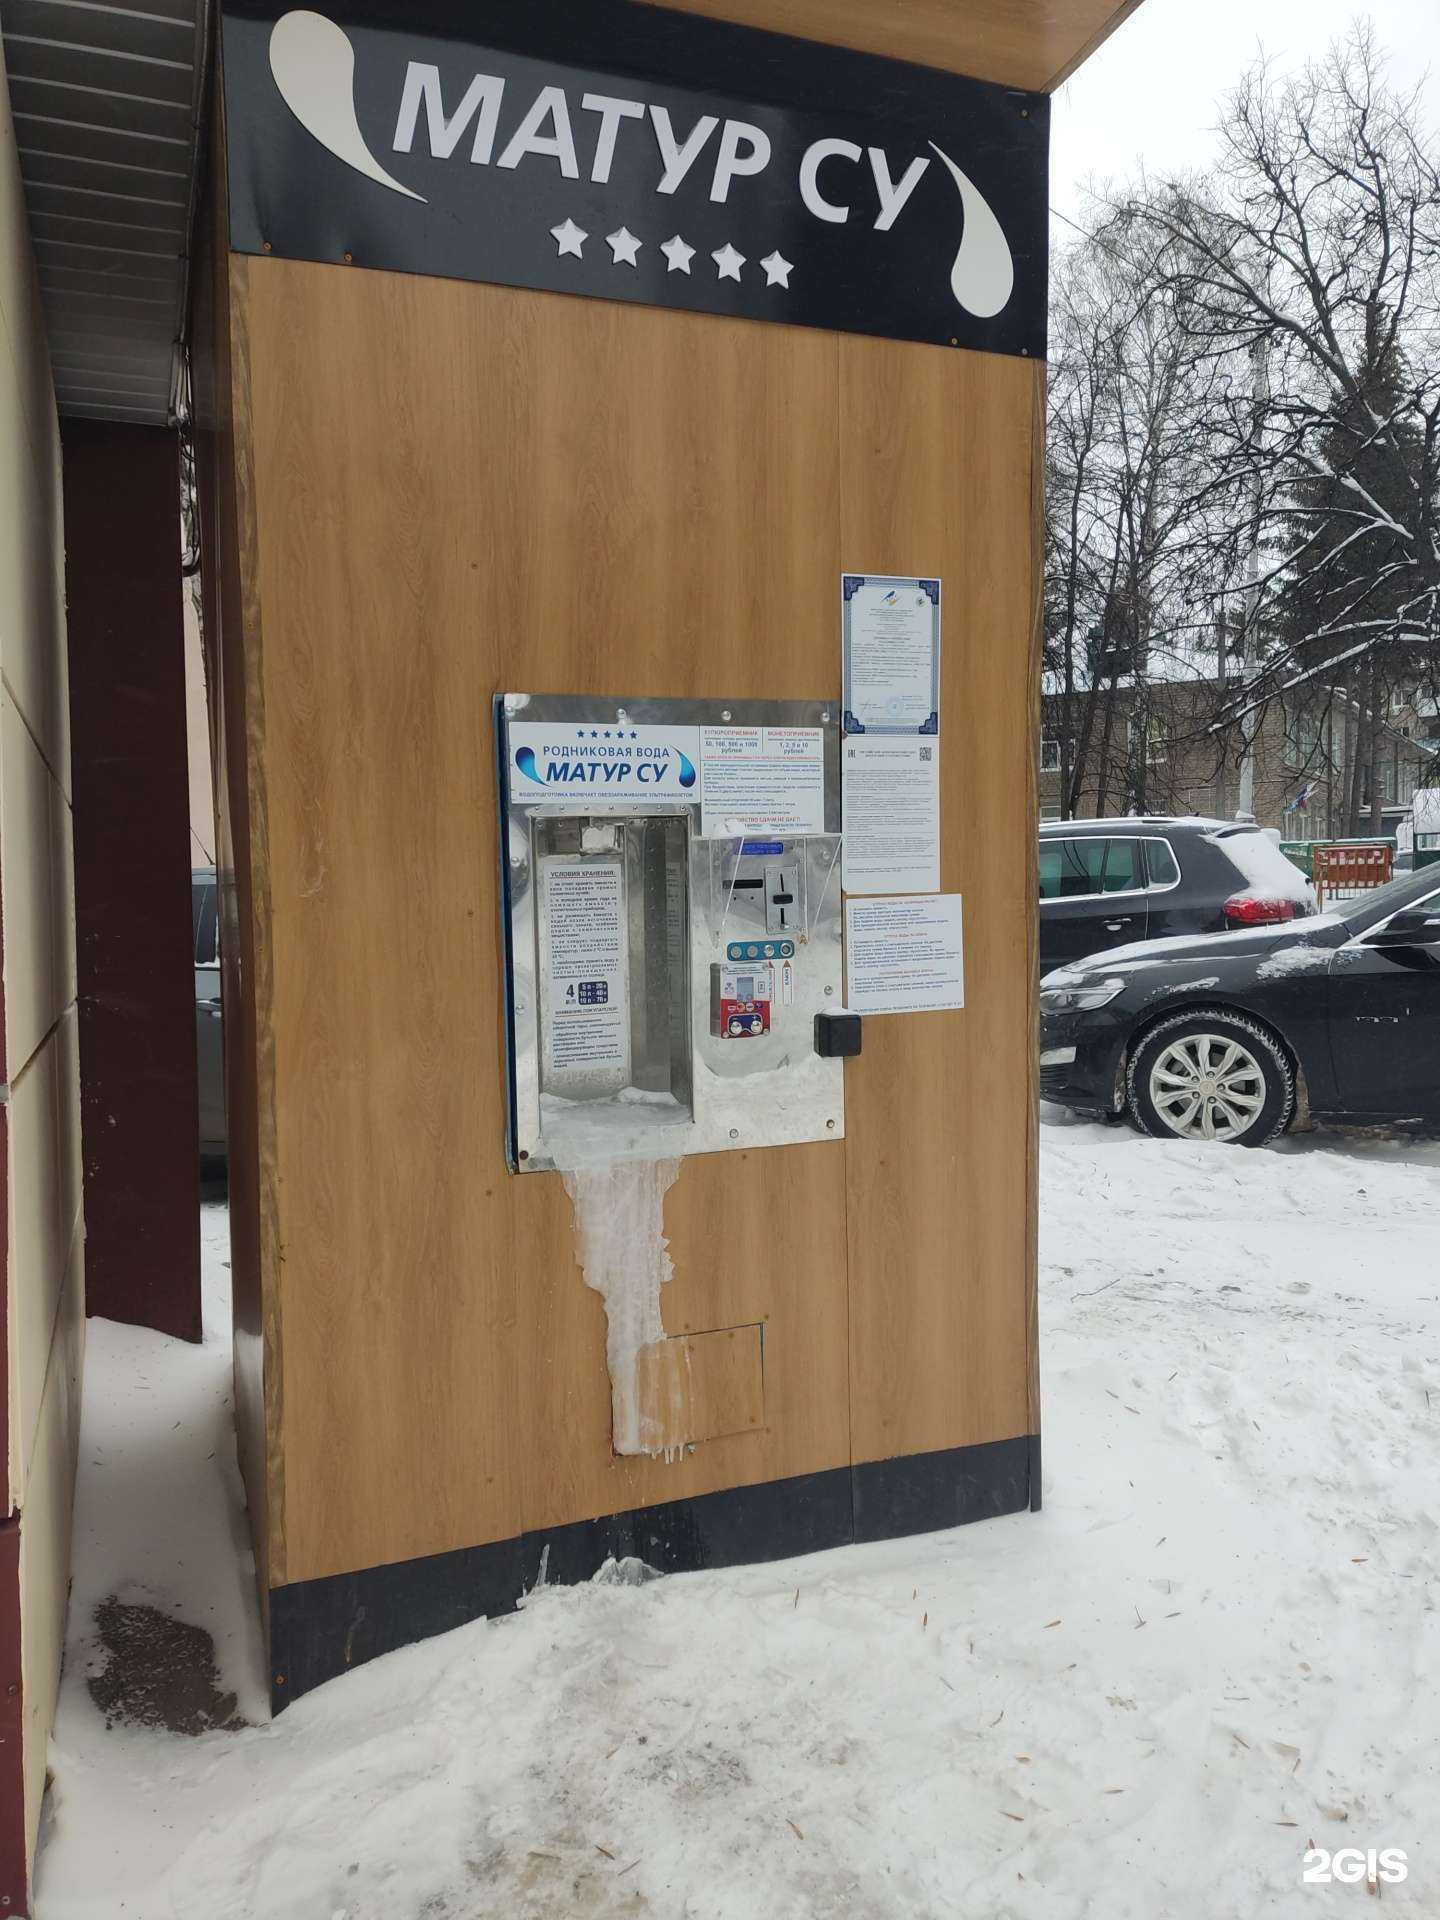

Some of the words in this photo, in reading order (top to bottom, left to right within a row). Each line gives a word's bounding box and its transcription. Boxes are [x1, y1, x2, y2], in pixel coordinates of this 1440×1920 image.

[393, 61, 771, 204] МАТУР
[800, 138, 931, 232] СУ
[543, 746, 632, 757] РОДНИКОВАЯ
[636, 747, 670, 758] ВОДА
[546, 762, 632, 782] МАТУР
[636, 763, 669, 783] СУ
[566, 984, 575, 998] 4
